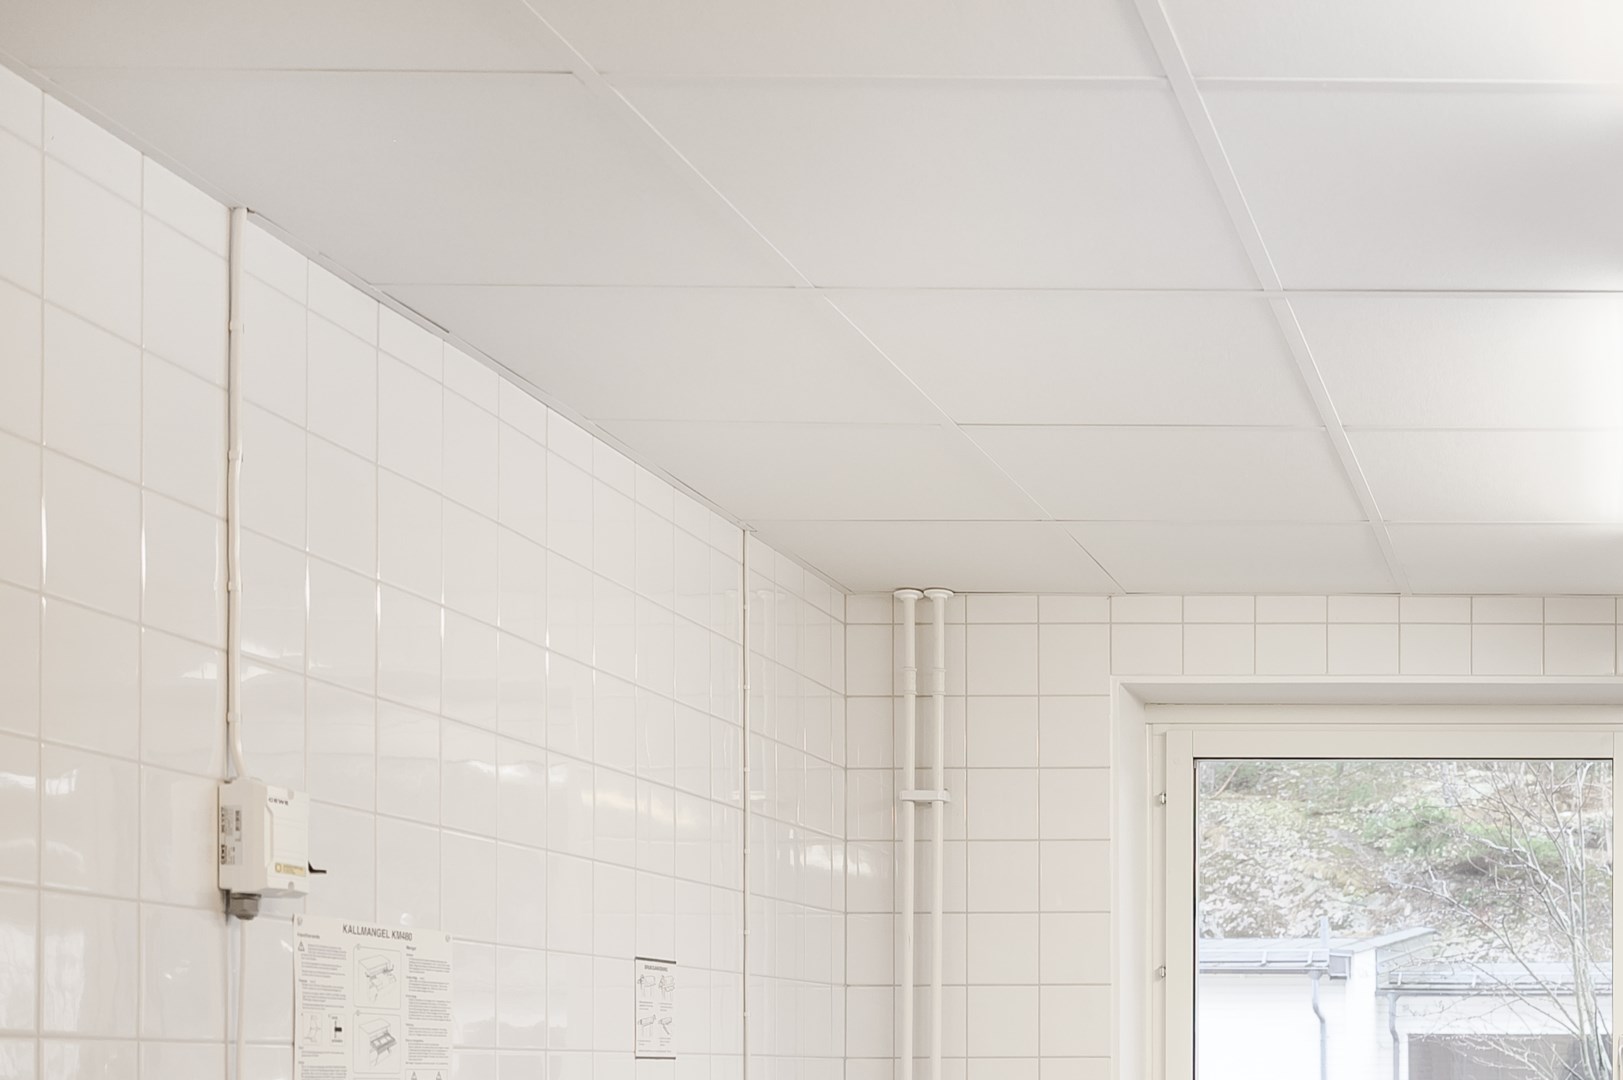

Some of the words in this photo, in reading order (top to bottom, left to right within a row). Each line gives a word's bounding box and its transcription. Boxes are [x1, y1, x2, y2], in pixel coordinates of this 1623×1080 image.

[268, 797, 288, 805] CEWE
[342, 923, 390, 939] KALLMANGEL
[391, 930, 412, 942] KM480
